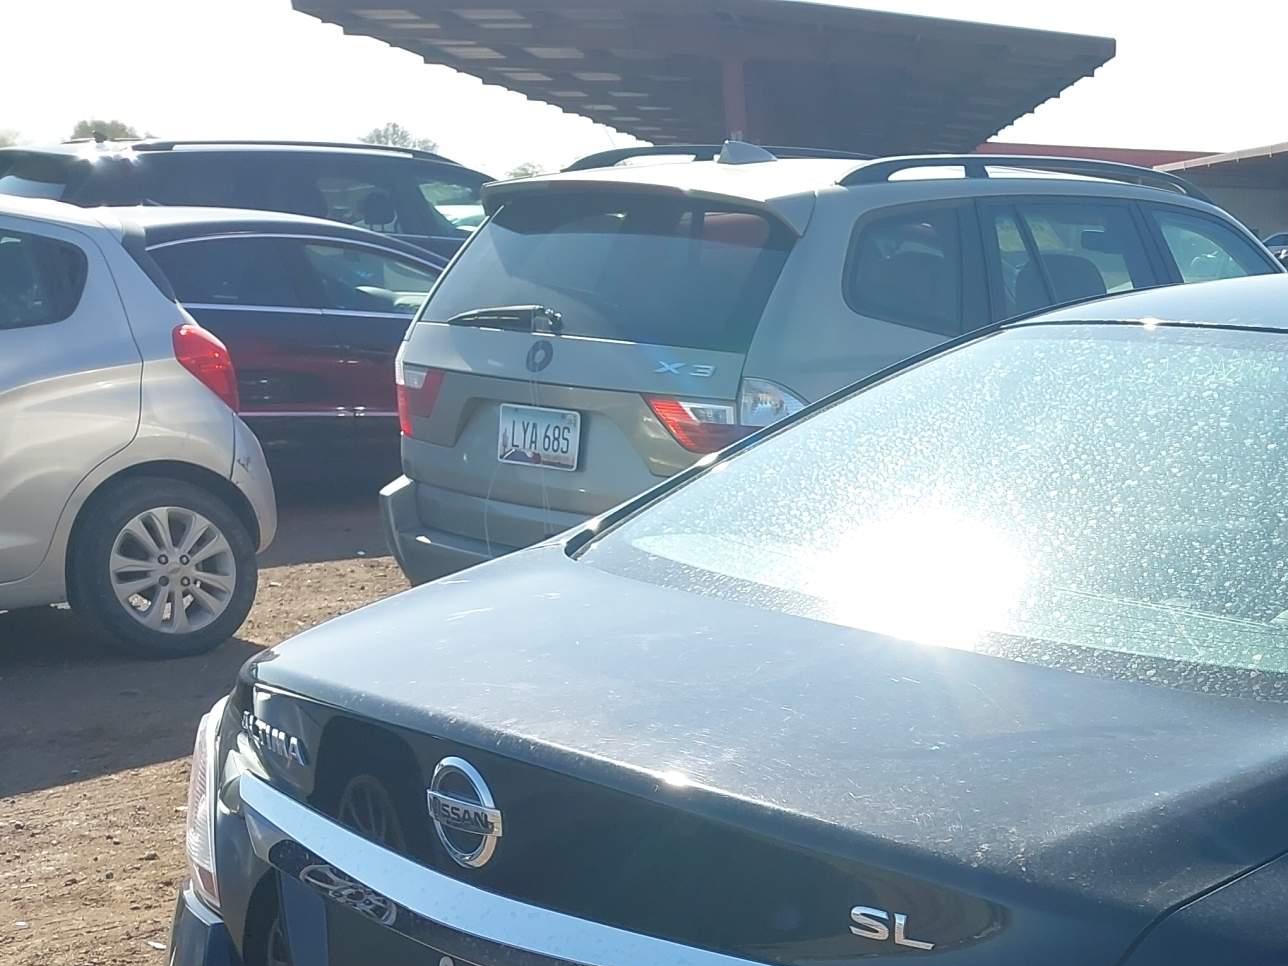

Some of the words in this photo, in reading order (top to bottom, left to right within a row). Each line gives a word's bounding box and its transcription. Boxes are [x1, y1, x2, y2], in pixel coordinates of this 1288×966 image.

[653, 360, 716, 377] X3
[511, 419, 540, 450] LYA
[241, 709, 305, 769] ALTIMA
[848, 905, 936, 951] SL
